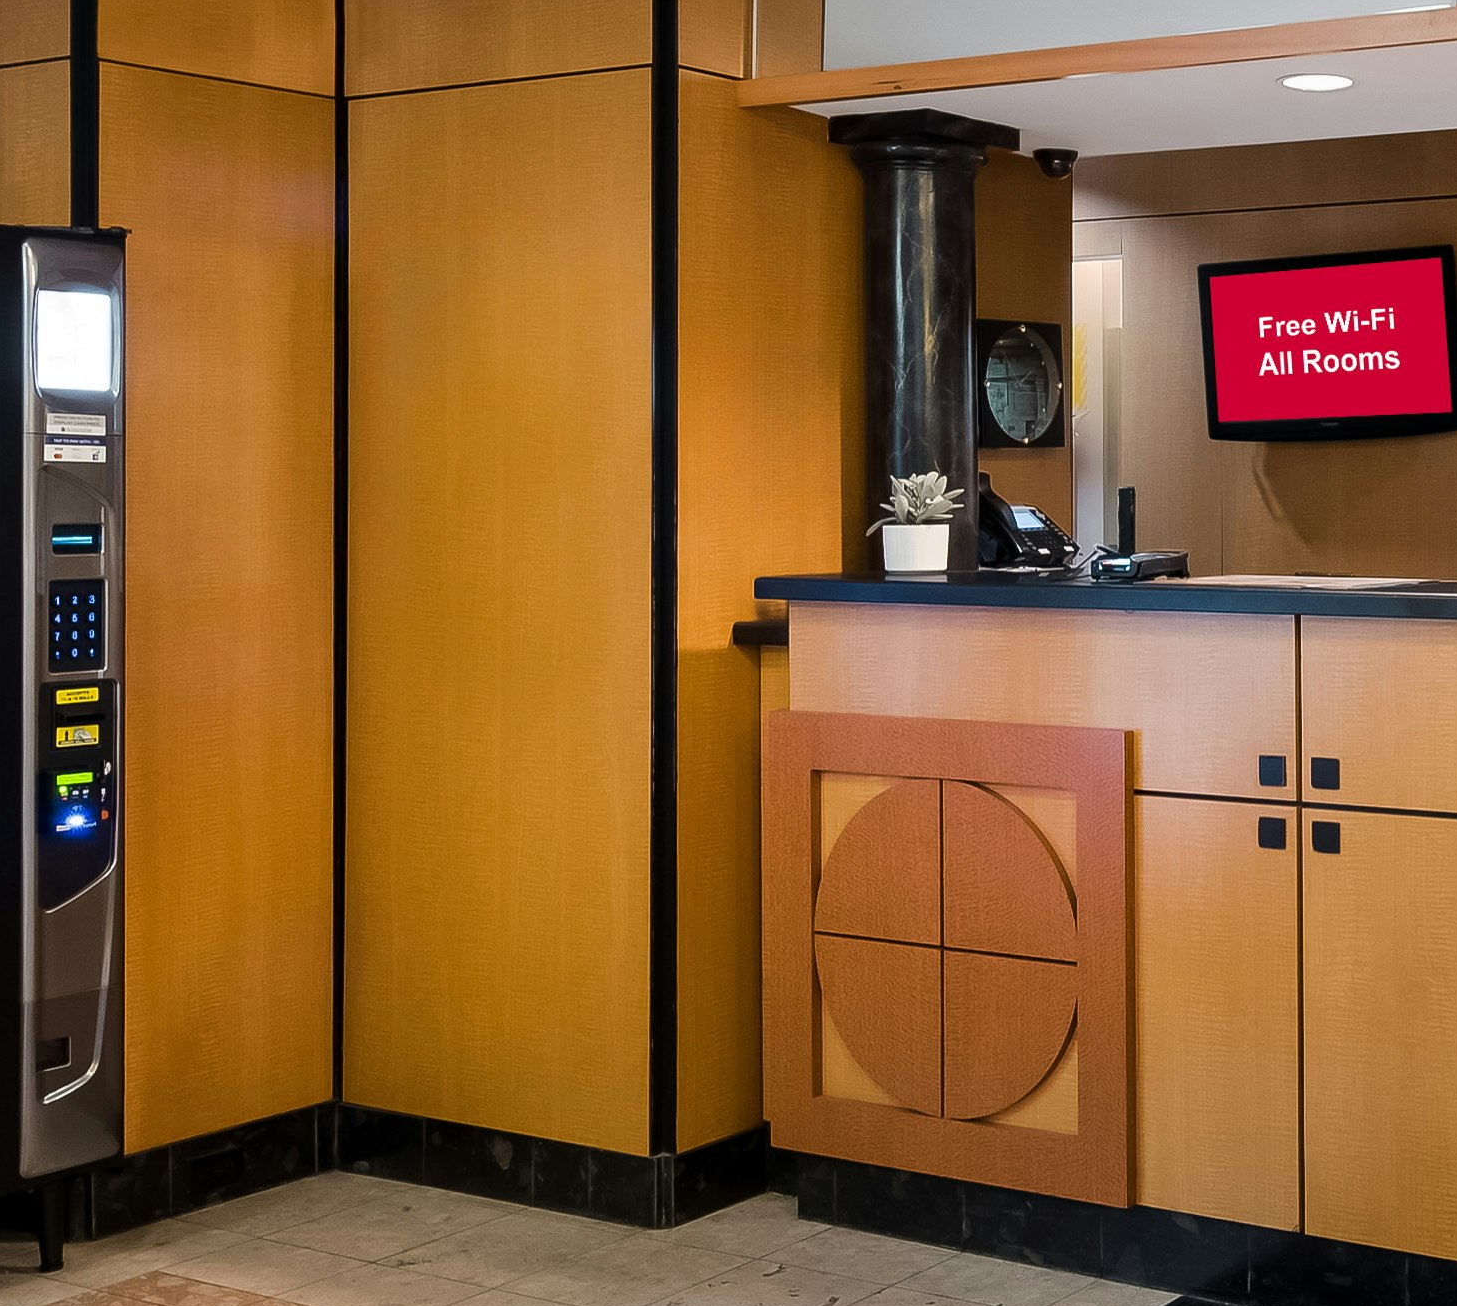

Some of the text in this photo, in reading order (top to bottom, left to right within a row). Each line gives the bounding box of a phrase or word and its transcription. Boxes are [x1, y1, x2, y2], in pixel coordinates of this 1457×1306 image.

[1258, 307, 1396, 338] Free Wi-Fi
[1259, 349, 1401, 376] All Rooms
[72, 595, 78, 605] 2
[54, 614, 61, 623] 4
